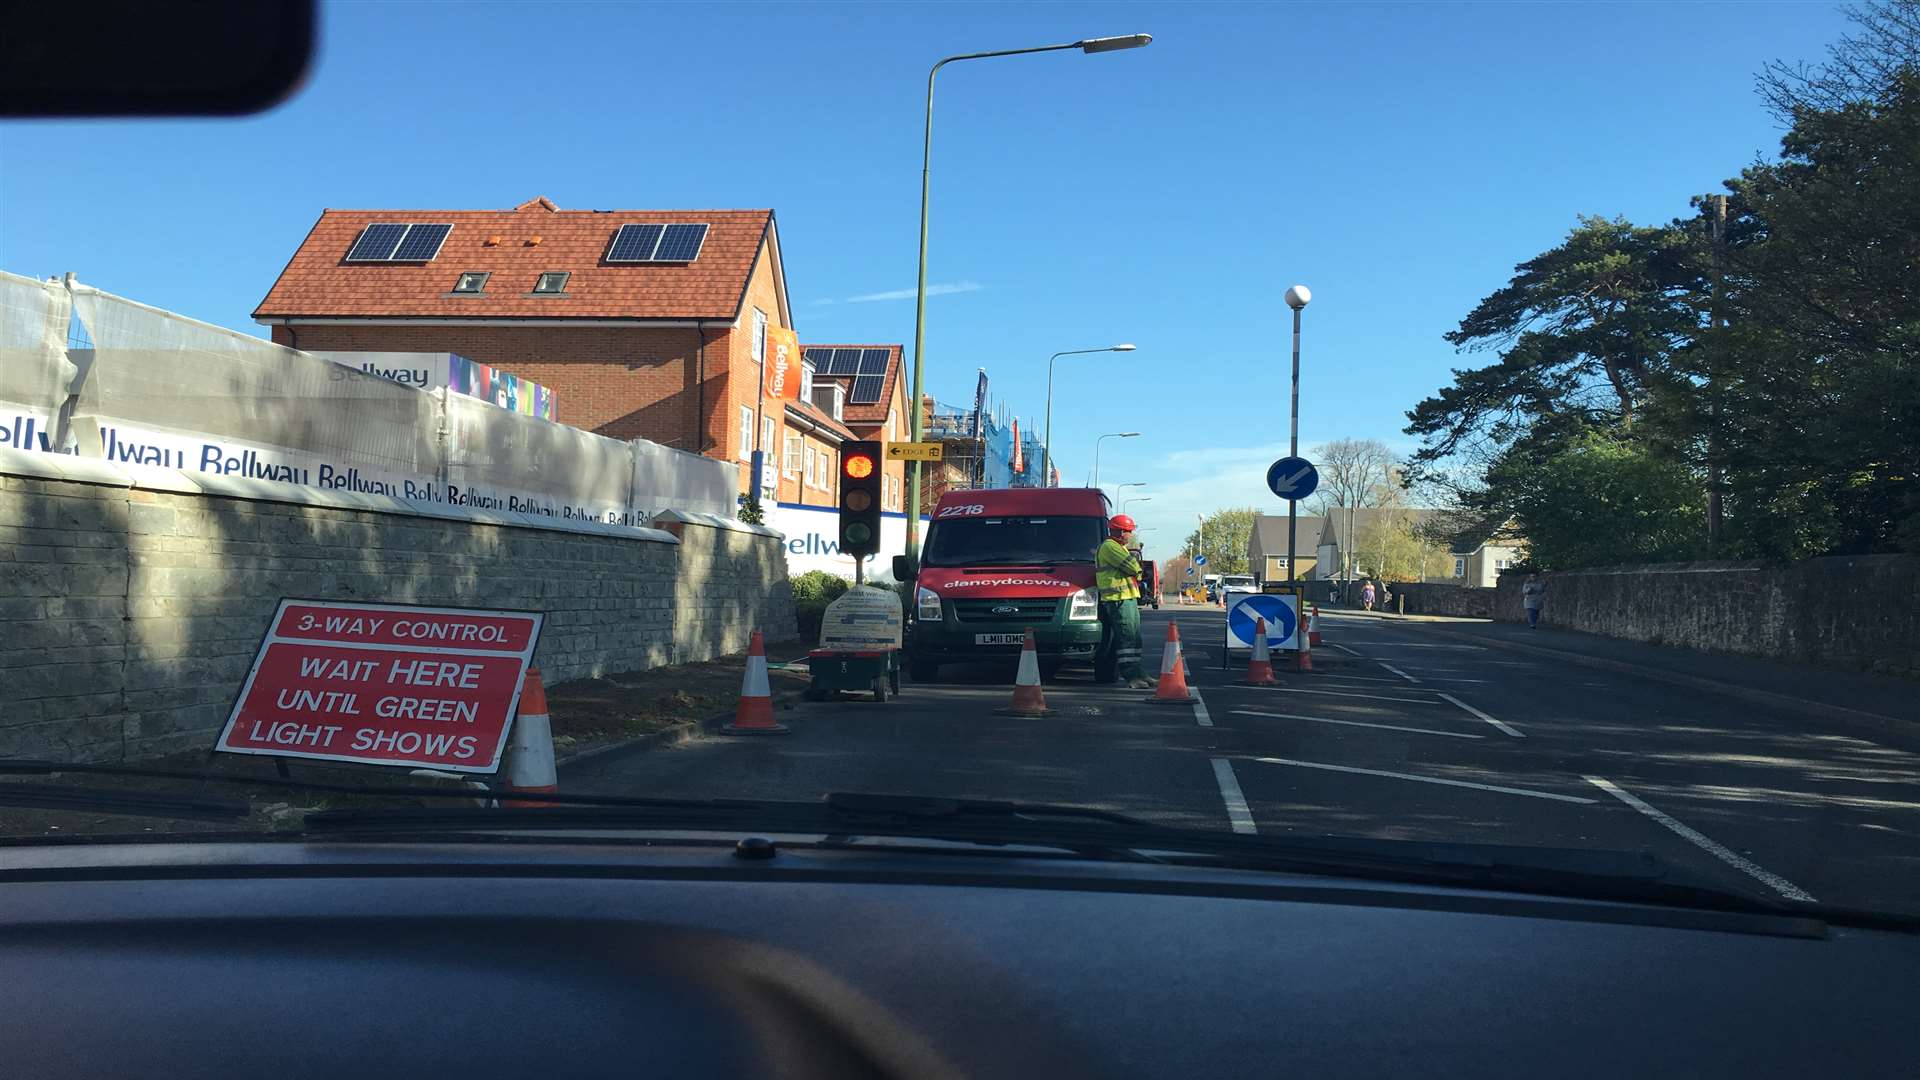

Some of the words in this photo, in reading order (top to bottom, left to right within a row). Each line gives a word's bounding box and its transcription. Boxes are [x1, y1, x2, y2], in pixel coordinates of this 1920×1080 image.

[939, 504, 984, 518] 2218
[944, 577, 1071, 589] clancydocwra
[297, 615, 384, 635] 3-WAY
[392, 620, 508, 643] CONTROL
[300, 657, 379, 682] WAIT
[387, 659, 485, 689] HERE
[276, 688, 360, 715] UNTIL
[375, 696, 479, 723] GREEN
[249, 720, 342, 747] LIGHT
[351, 728, 479, 759] SHOWS
